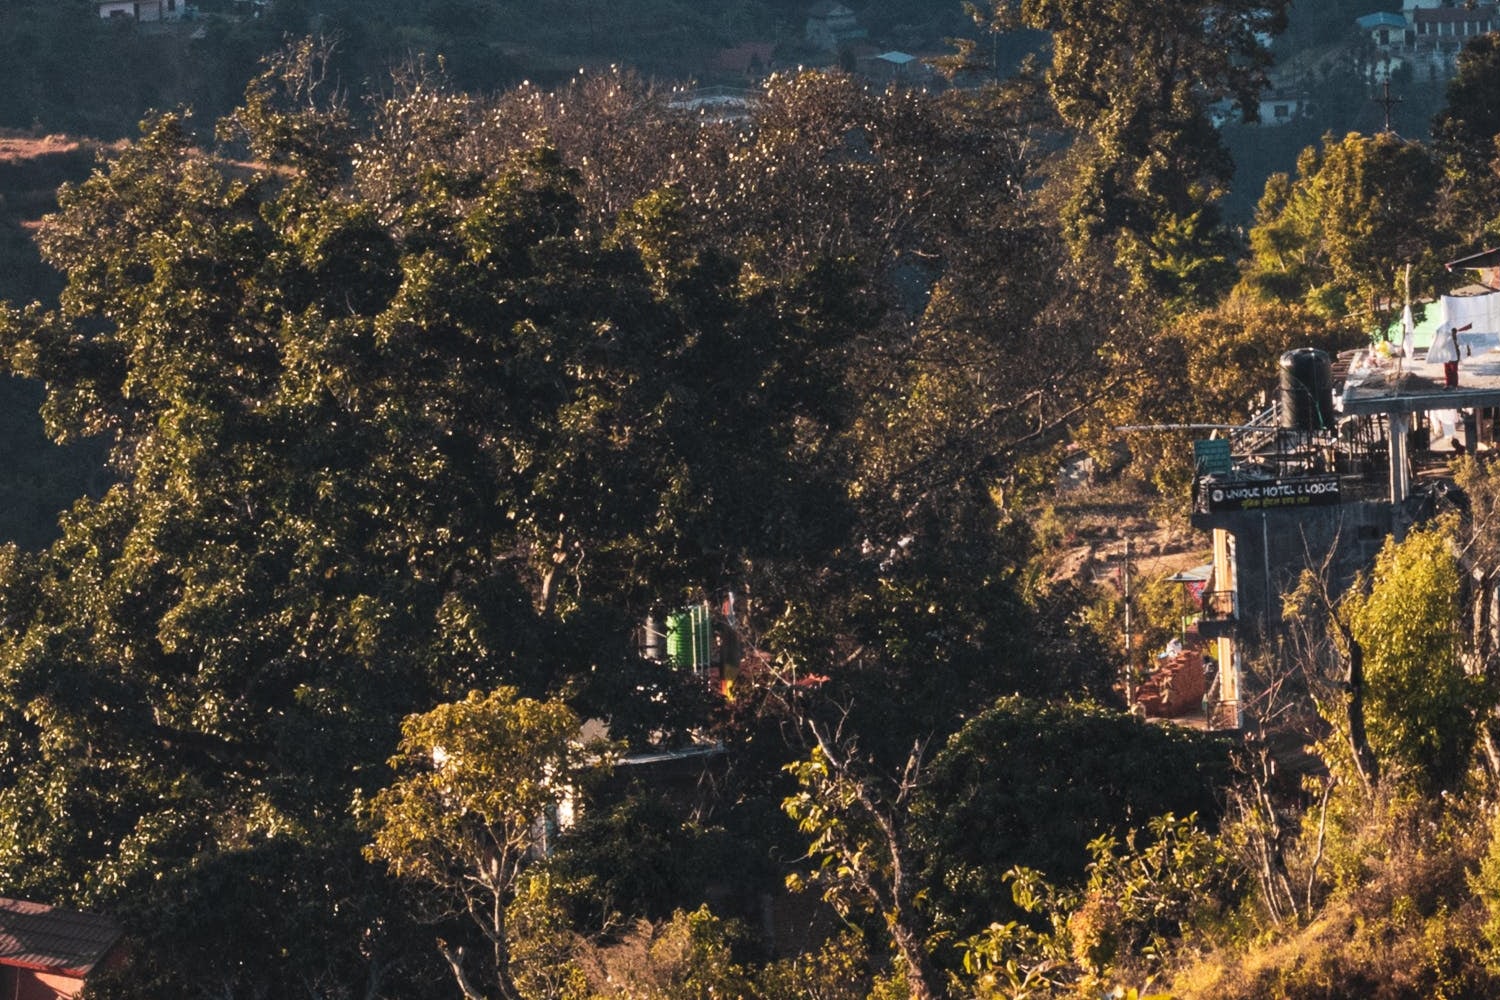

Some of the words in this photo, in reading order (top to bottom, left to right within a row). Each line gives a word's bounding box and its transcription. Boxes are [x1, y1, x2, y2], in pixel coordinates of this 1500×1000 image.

[1226, 487, 1260, 498] UNIQUE
[1262, 485, 1295, 497] HOTEL
[1305, 482, 1339, 494] LODGE
